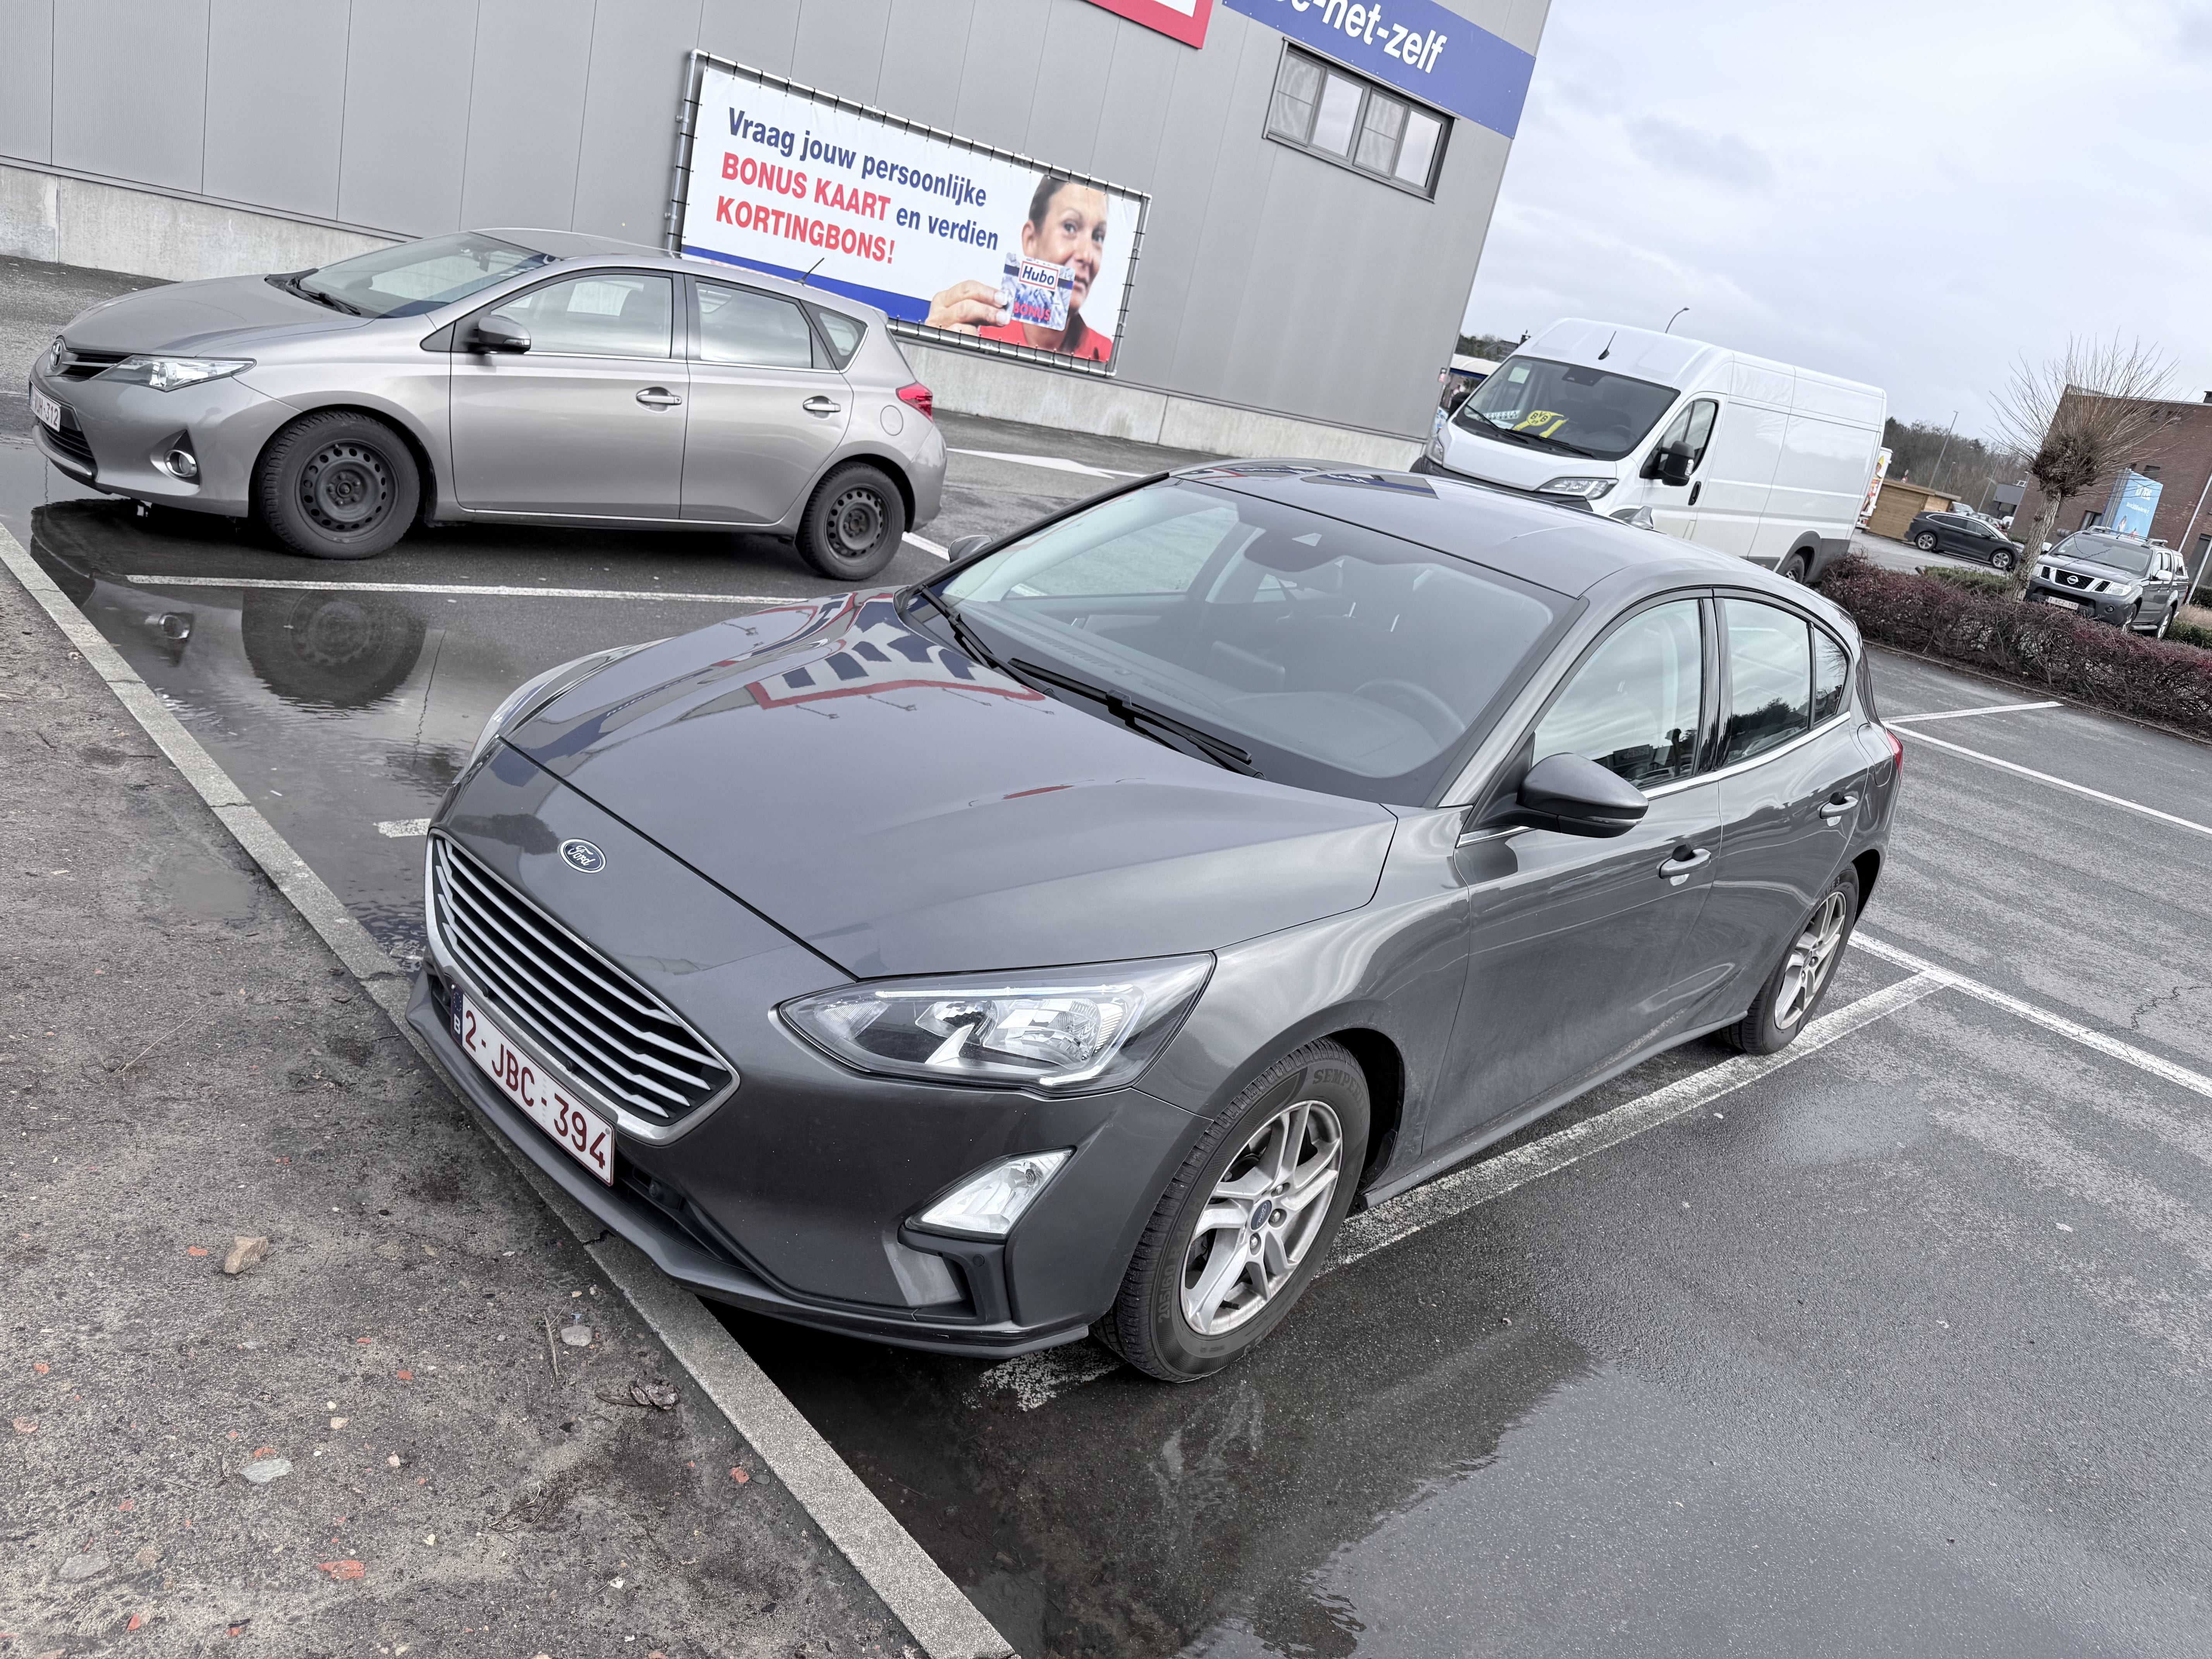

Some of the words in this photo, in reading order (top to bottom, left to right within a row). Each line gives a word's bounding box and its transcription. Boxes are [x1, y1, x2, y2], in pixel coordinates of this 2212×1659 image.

[729, 107, 795, 157] Vraag
[800, 130, 856, 169] jouw
[861, 155, 986, 207] persoonlijke
[722, 151, 807, 199] BONUS
[814, 178, 891, 221] KAART
[896, 208, 920, 230] en
[929, 215, 998, 251] verdien
[716, 195, 895, 264] KORTINGBONS!
[1022, 266, 1054, 285] Hubo
[1013, 301, 1051, 321] BONUS
[568, 845, 596, 866] Ford
[454, 1013, 461, 1035] B
[465, 1010, 606, 1169] 2-JBC-394
